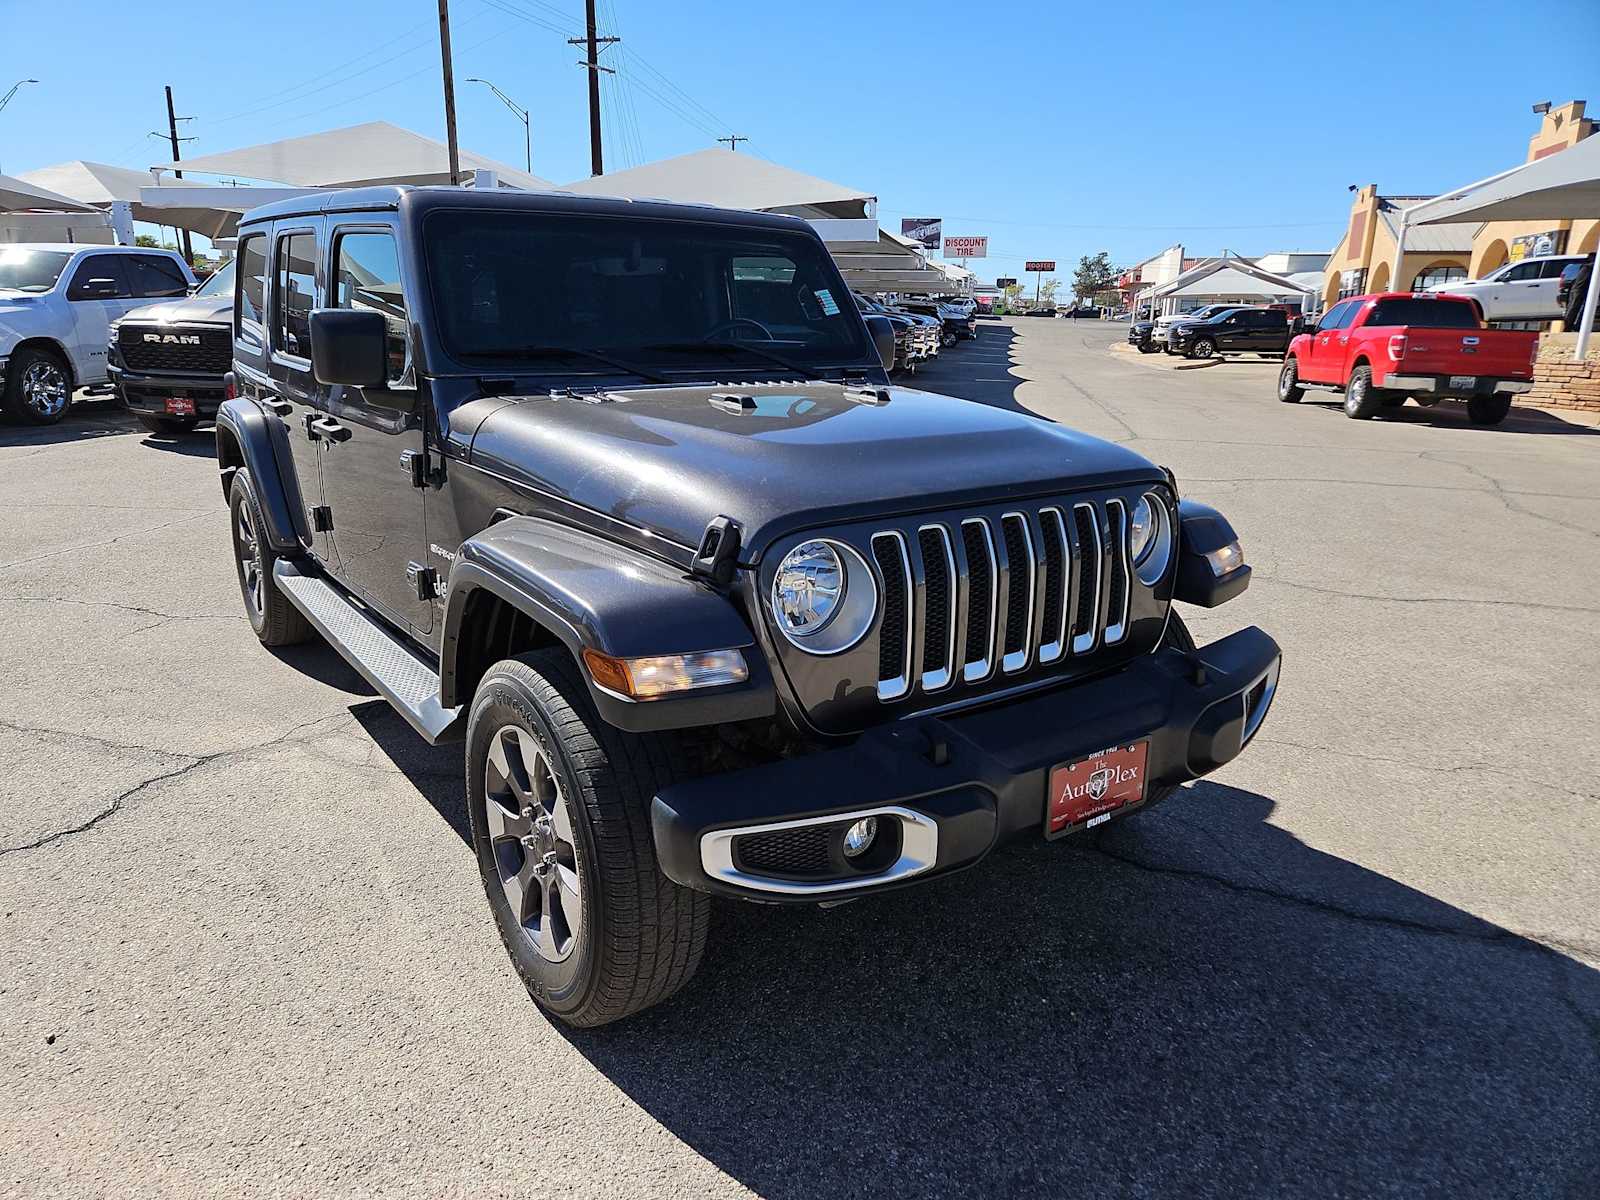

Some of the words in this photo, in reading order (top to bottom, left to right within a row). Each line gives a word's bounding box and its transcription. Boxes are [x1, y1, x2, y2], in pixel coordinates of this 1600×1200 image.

[945, 239, 985, 247] DISCOUNT
[956, 248, 974, 256] TIRE
[143, 334, 200, 344] RAM
[433, 574, 447, 598] Je
[1095, 760, 1107, 770] The
[1060, 765, 1138, 803] AutoPlex
